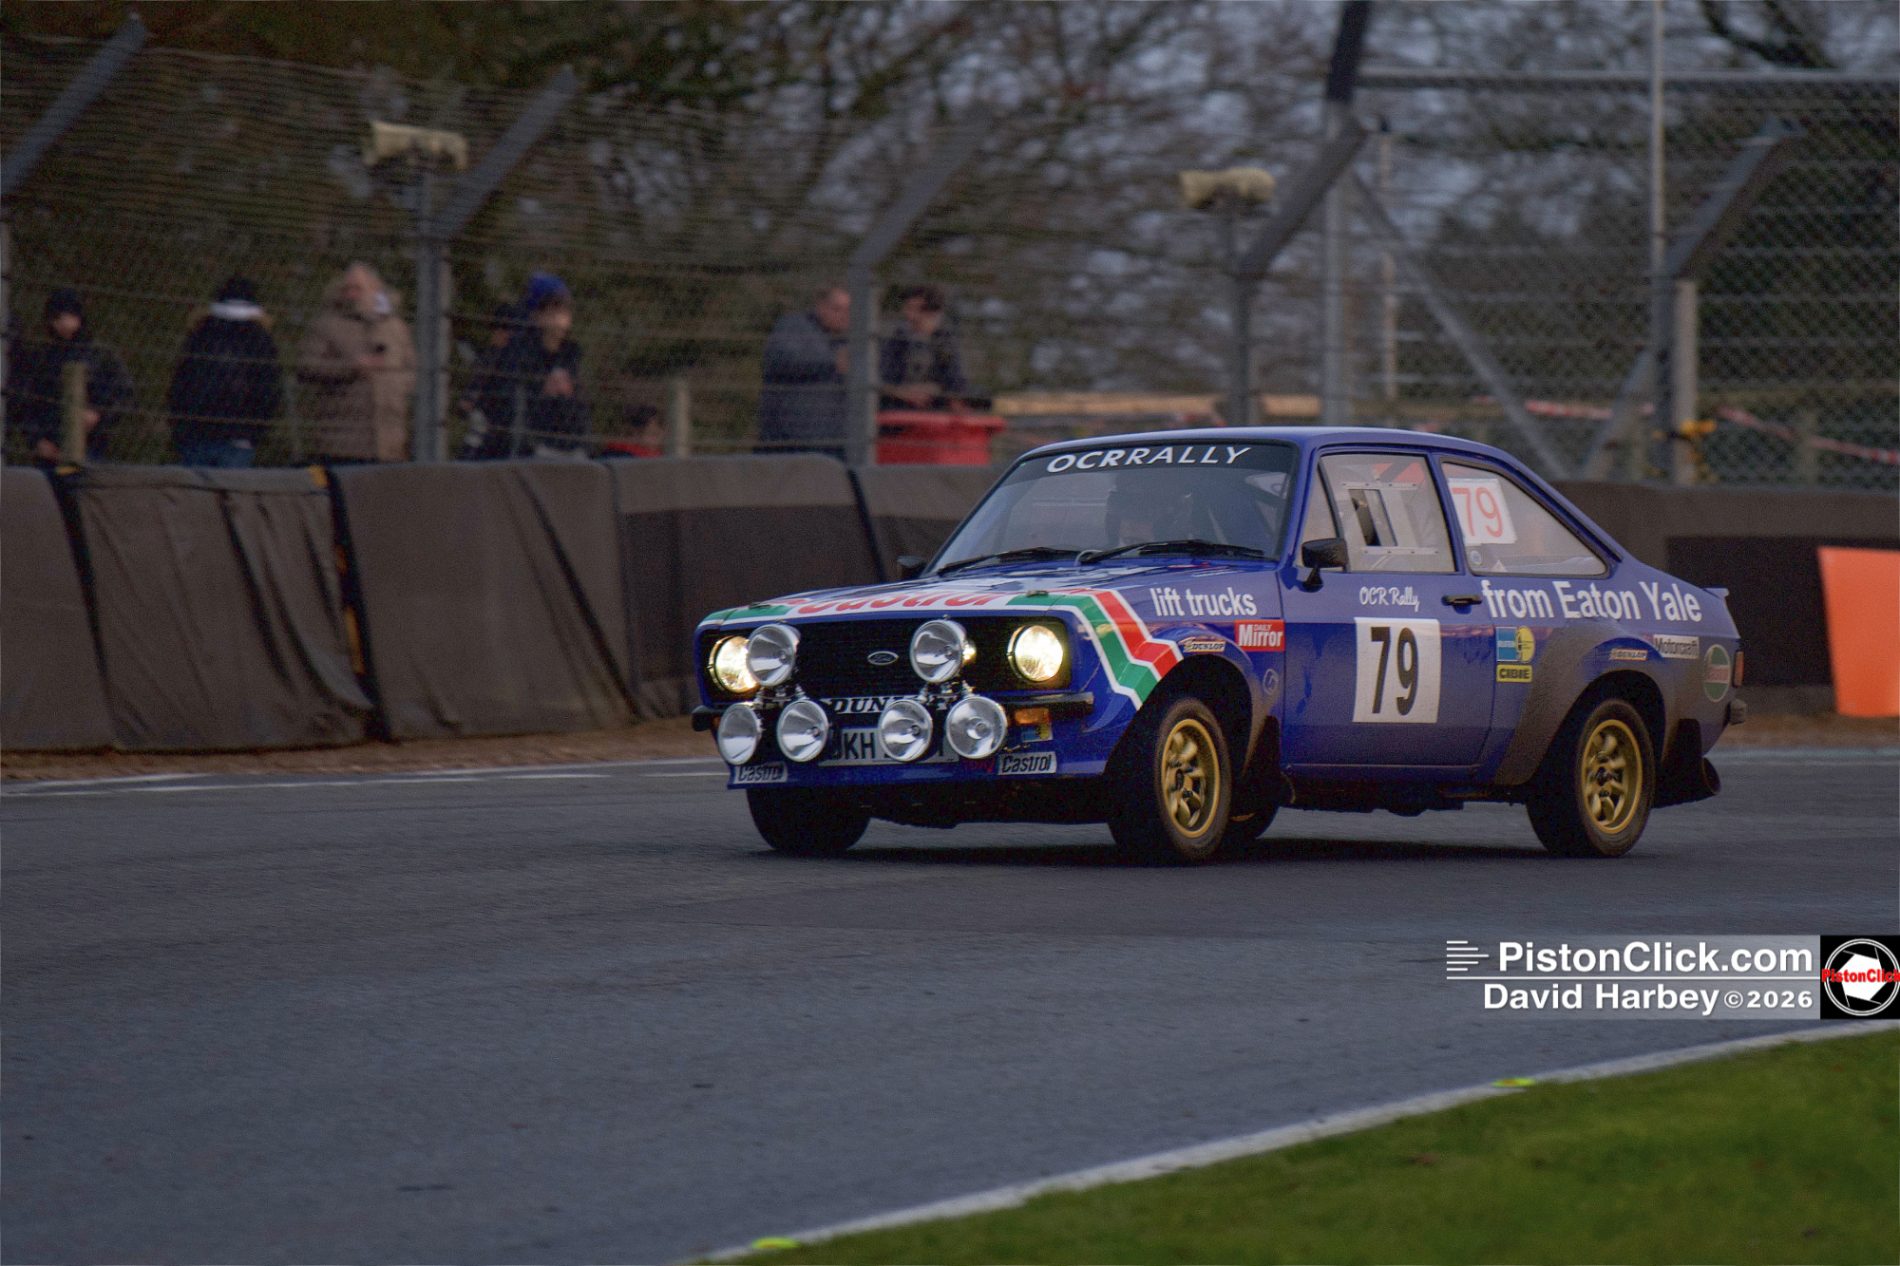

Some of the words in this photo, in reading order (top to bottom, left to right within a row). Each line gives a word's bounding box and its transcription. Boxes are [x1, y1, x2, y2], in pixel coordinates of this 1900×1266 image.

[1451, 487, 1503, 538] 79
[1150, 587, 1185, 616] lift
[1186, 587, 1257, 616] trucks
[1359, 587, 1389, 605] OCR
[1388, 587, 1420, 612] Rally
[1481, 580, 1554, 618] from
[1552, 581, 1641, 619] Eaton
[1638, 582, 1702, 622] Yale
[1238, 624, 1283, 647] Mirror
[1371, 626, 1419, 716] 79
[1002, 754, 1052, 773] Castrol
